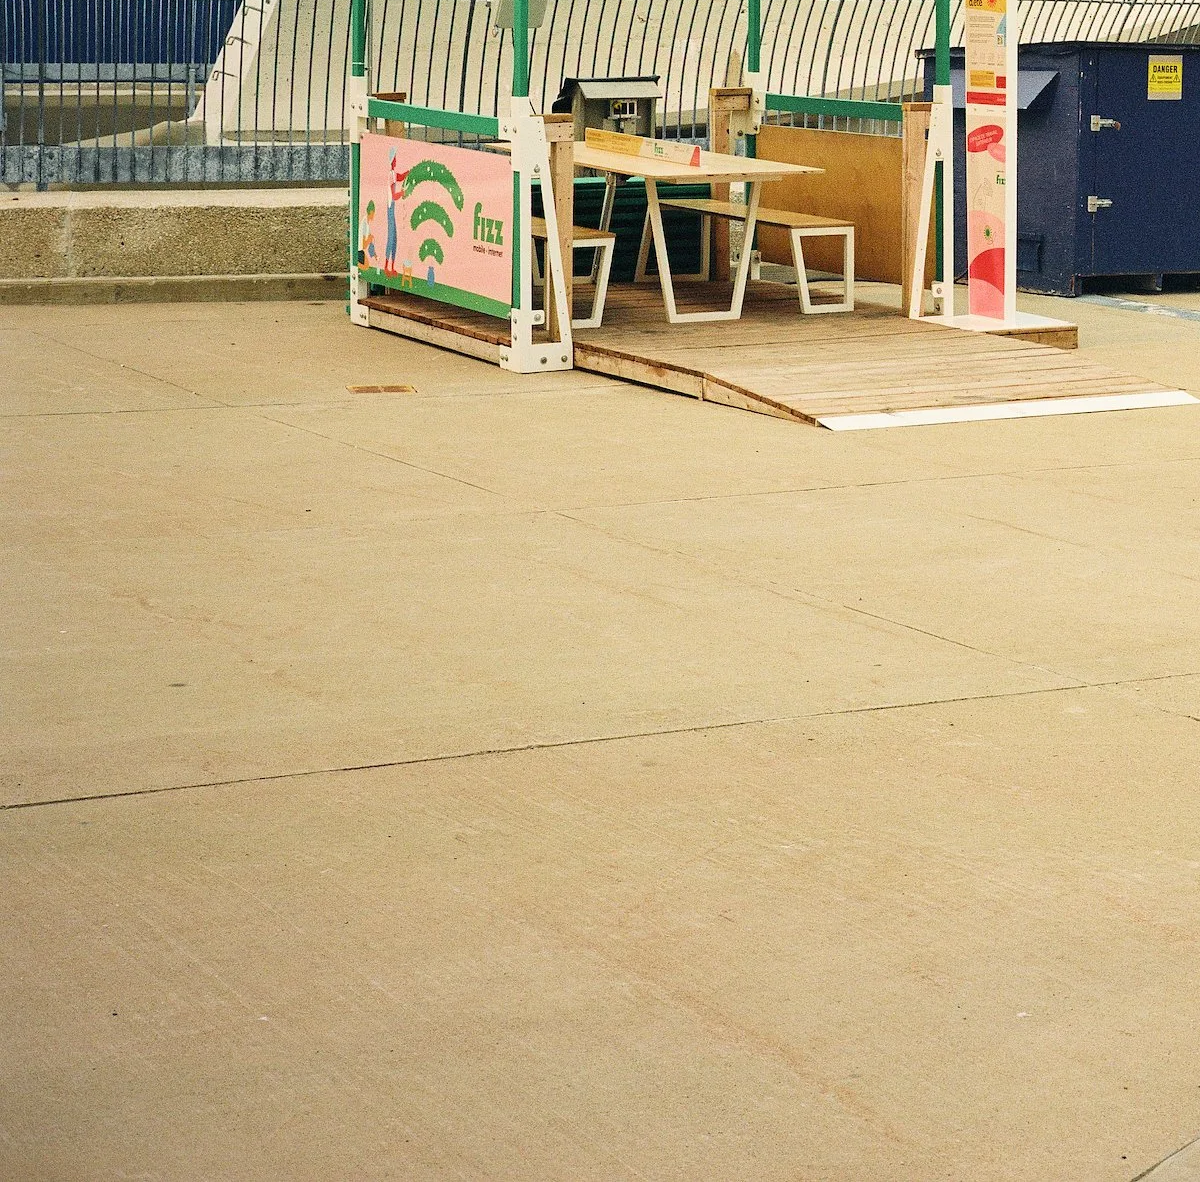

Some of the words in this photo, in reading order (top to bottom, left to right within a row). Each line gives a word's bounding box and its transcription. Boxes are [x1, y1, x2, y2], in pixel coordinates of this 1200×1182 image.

[1153, 65, 1178, 73] DANGER
[473, 202, 504, 246] fizz
[473, 245, 486, 254] mobile
[488, 247, 503, 258] internet
